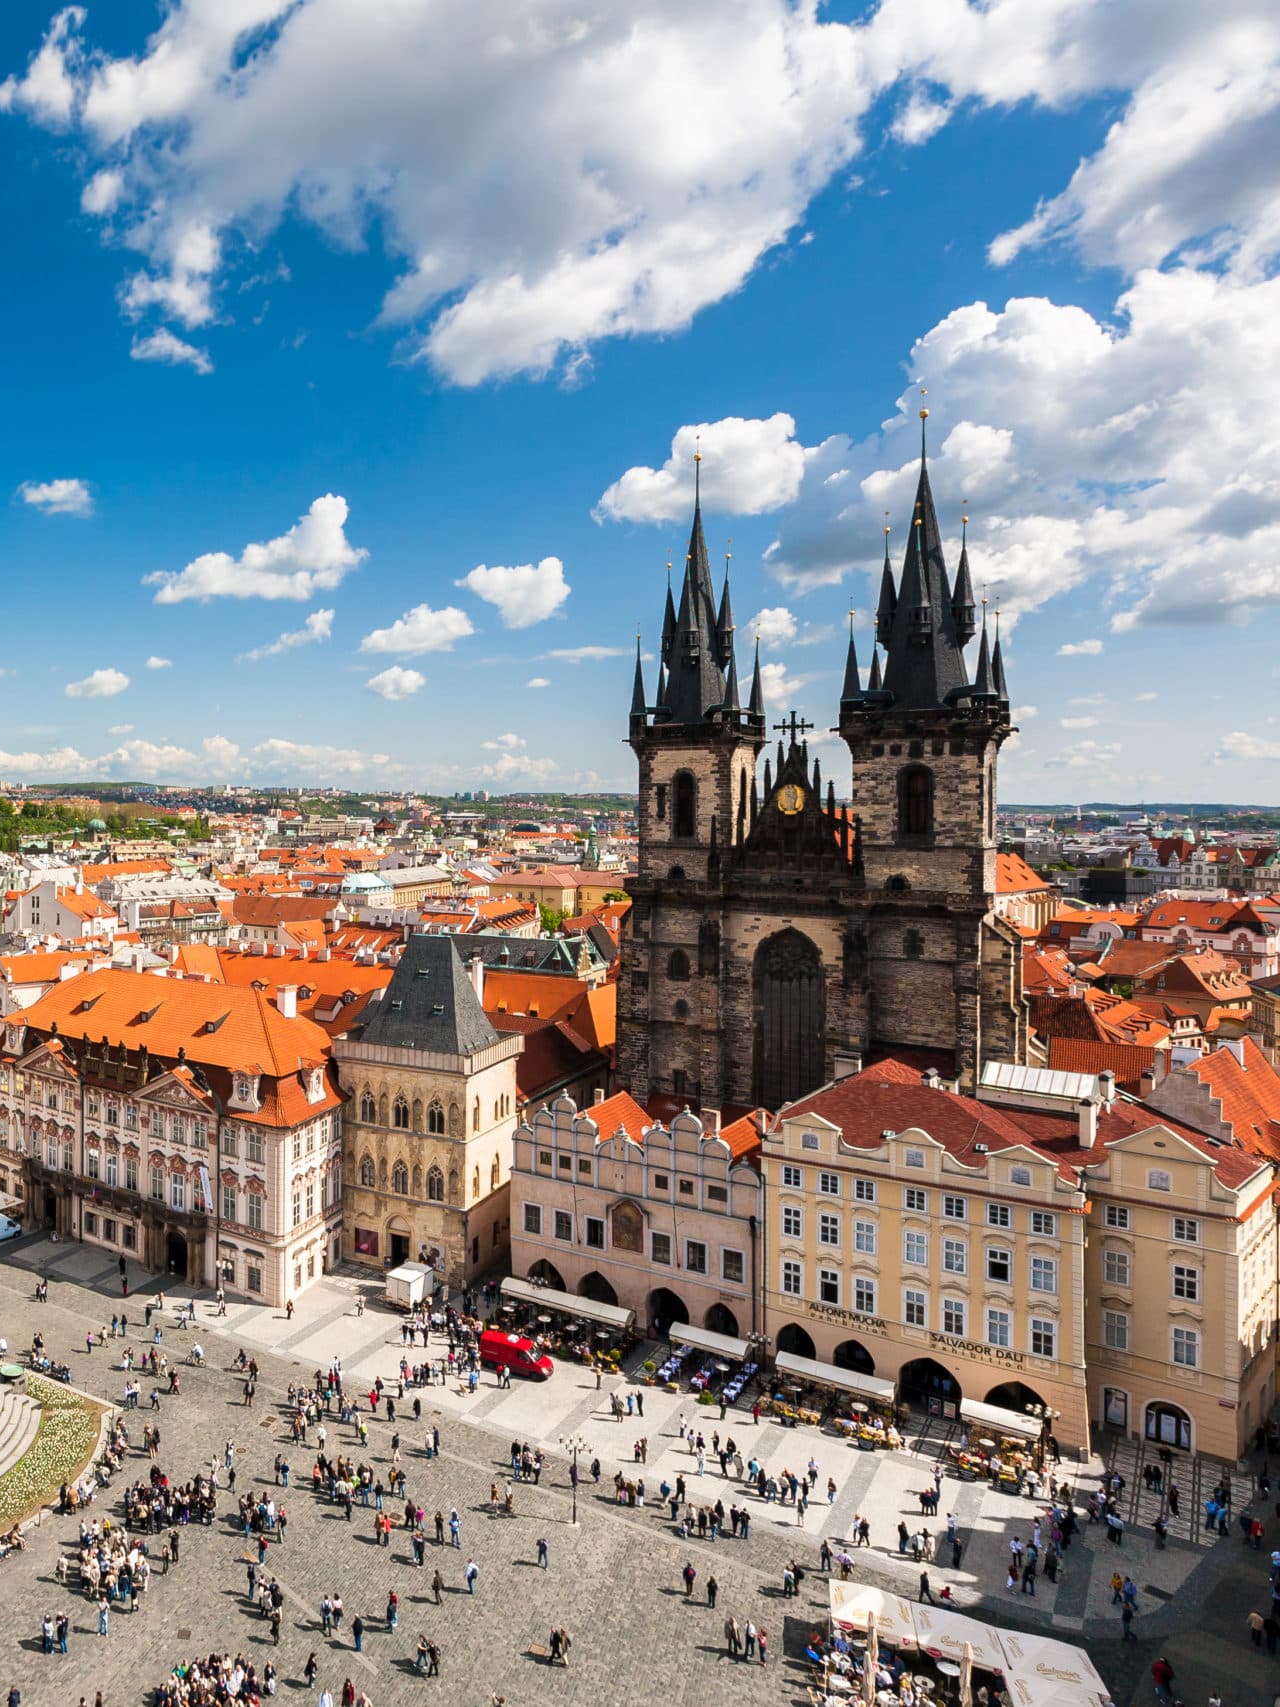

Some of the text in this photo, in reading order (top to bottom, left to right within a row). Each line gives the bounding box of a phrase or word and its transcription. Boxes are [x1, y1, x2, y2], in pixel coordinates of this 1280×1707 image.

[809, 1303, 887, 1329] ALFONS MUCHA
[810, 1313, 888, 1336] exhibition
[930, 1333, 1024, 1363] SALVADOR DALI
[931, 1343, 1023, 1371] exhibition
